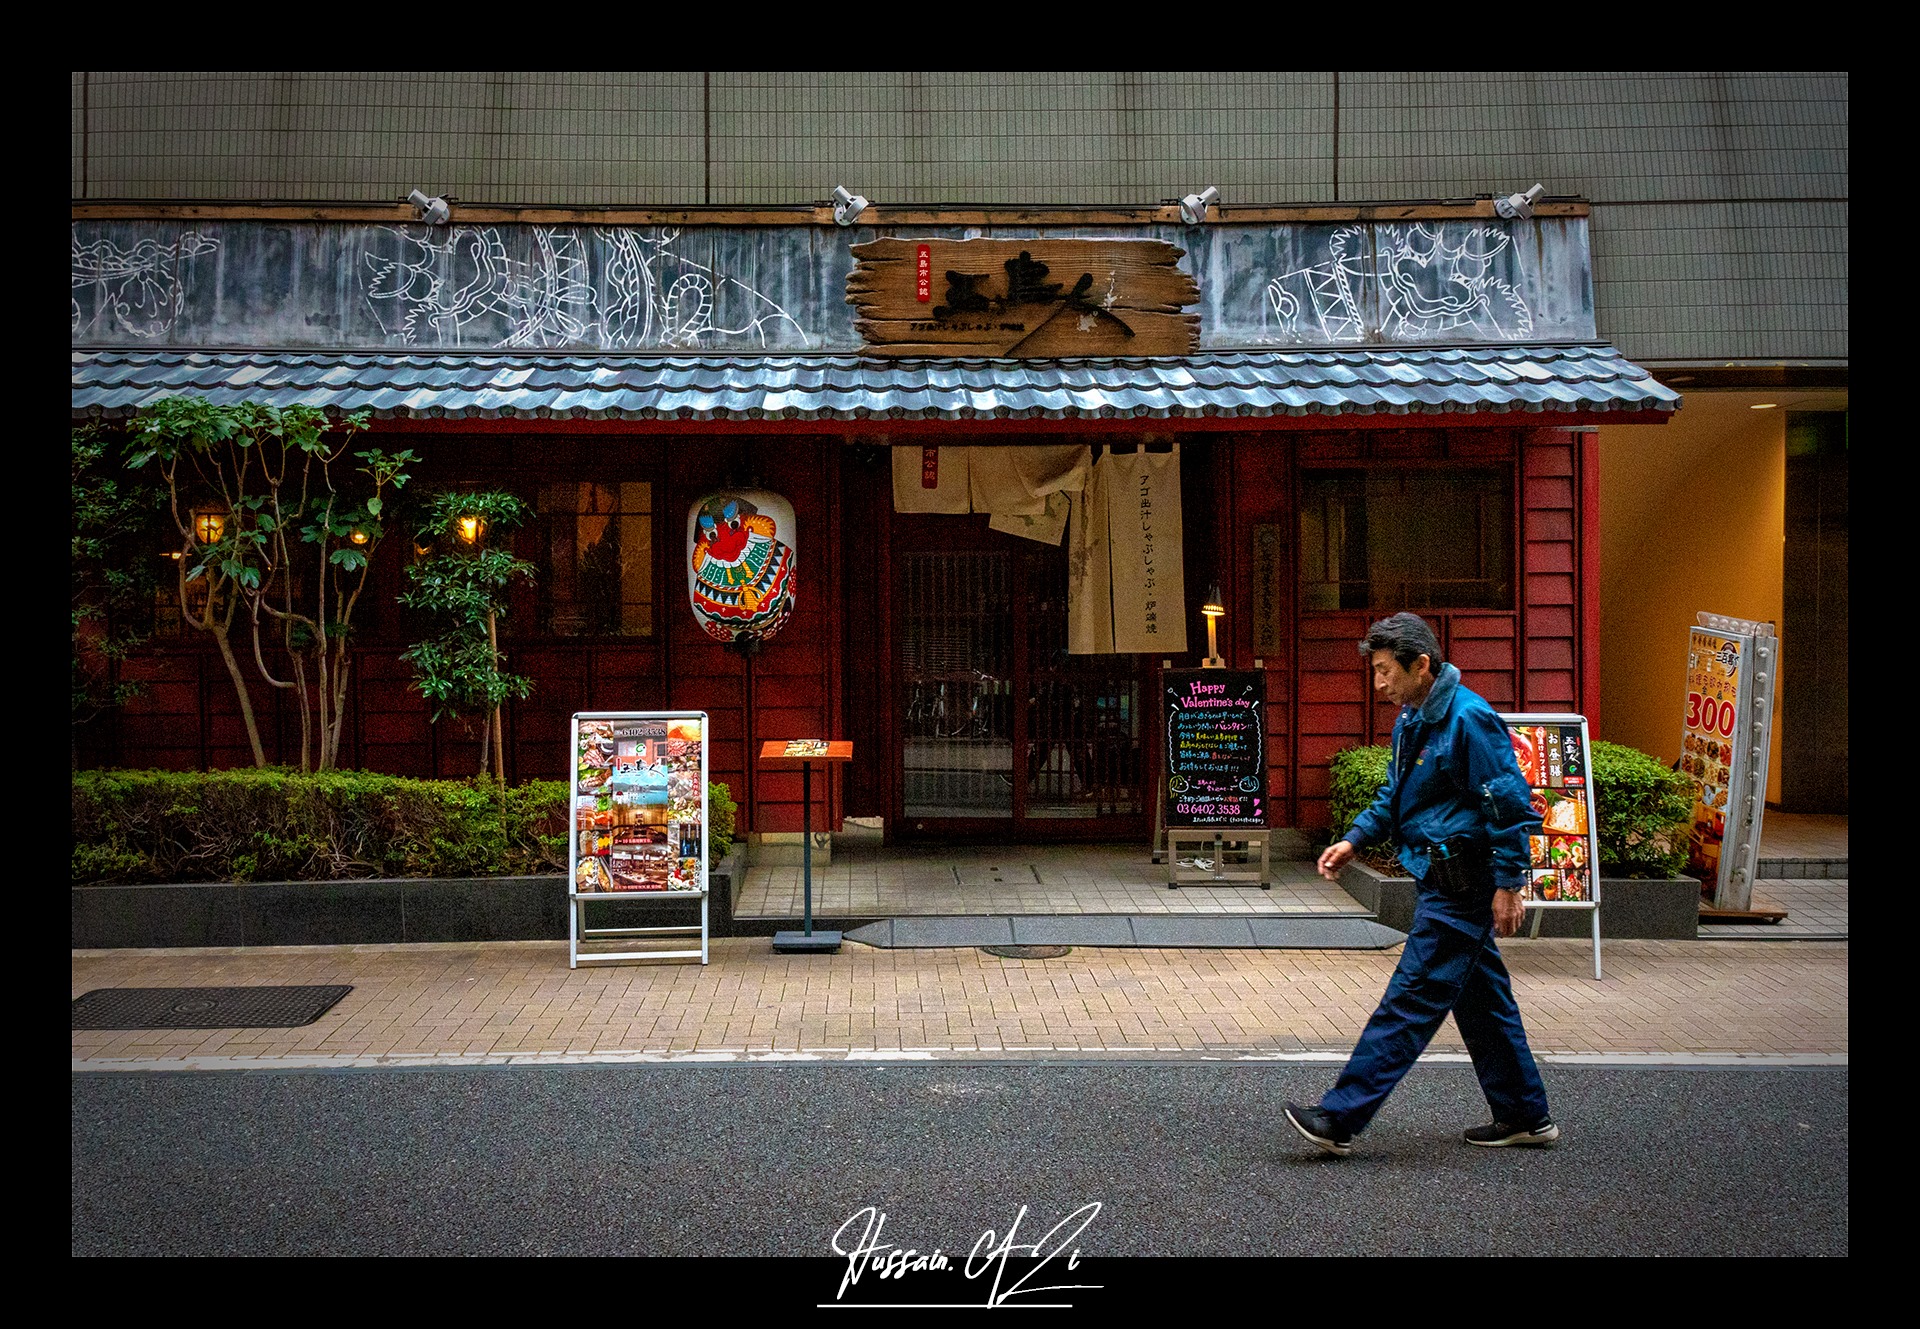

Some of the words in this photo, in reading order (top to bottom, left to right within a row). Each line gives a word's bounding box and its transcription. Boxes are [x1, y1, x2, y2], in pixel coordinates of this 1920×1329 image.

[1189, 680, 1226, 695] Happy
[1180, 696, 1234, 708] Valentine's
[1234, 698, 1251, 708] day
[1685, 691, 1735, 738] 300
[1548, 733, 1563, 777] お昼膳
[1176, 803, 1190, 814] 03
[1190, 803, 1216, 815] 6402
[1216, 804, 1241, 815] 3538
